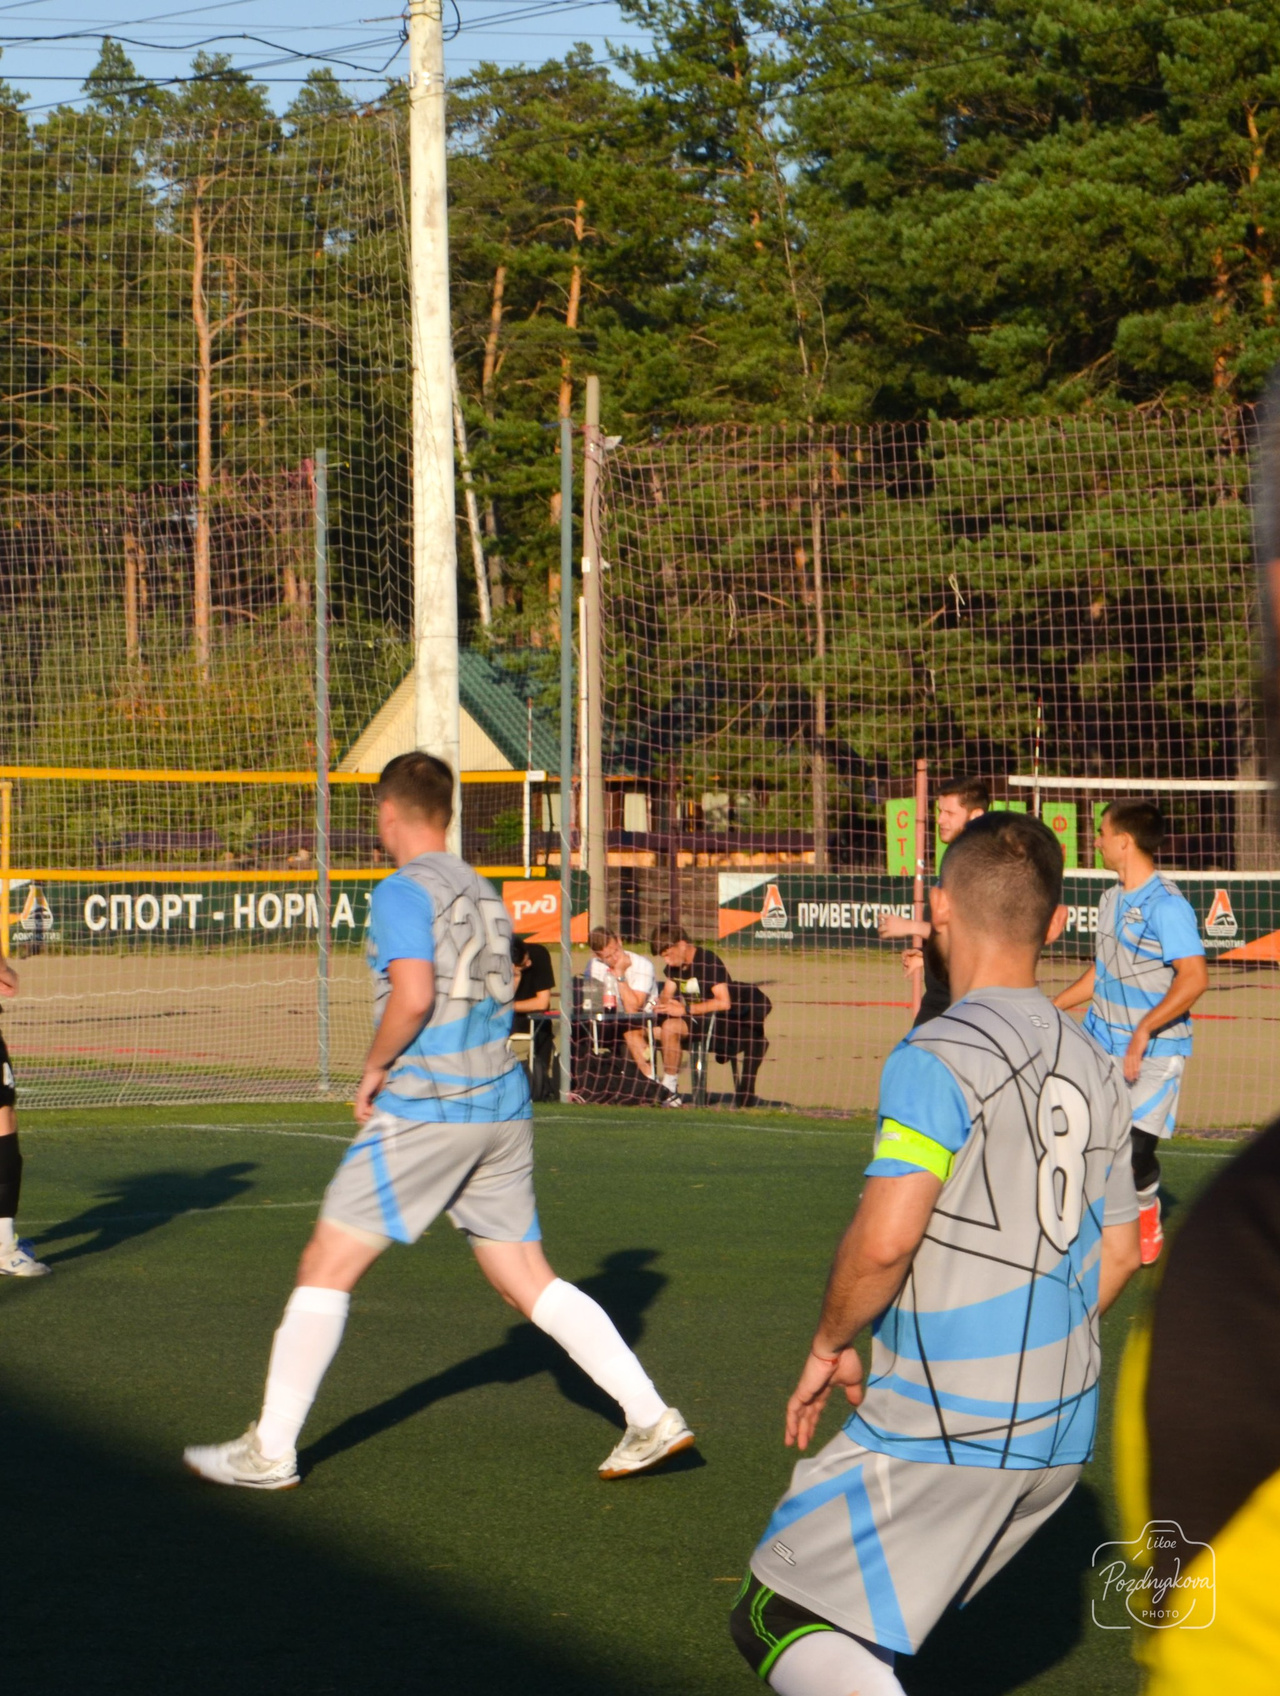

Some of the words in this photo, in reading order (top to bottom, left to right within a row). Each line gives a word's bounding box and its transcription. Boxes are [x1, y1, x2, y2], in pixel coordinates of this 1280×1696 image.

[83, 893, 203, 931] СПОРТ
[233, 892, 356, 930] НОРМА
[450, 894, 515, 1004] 25
[1036, 1072, 1091, 1255] 8
